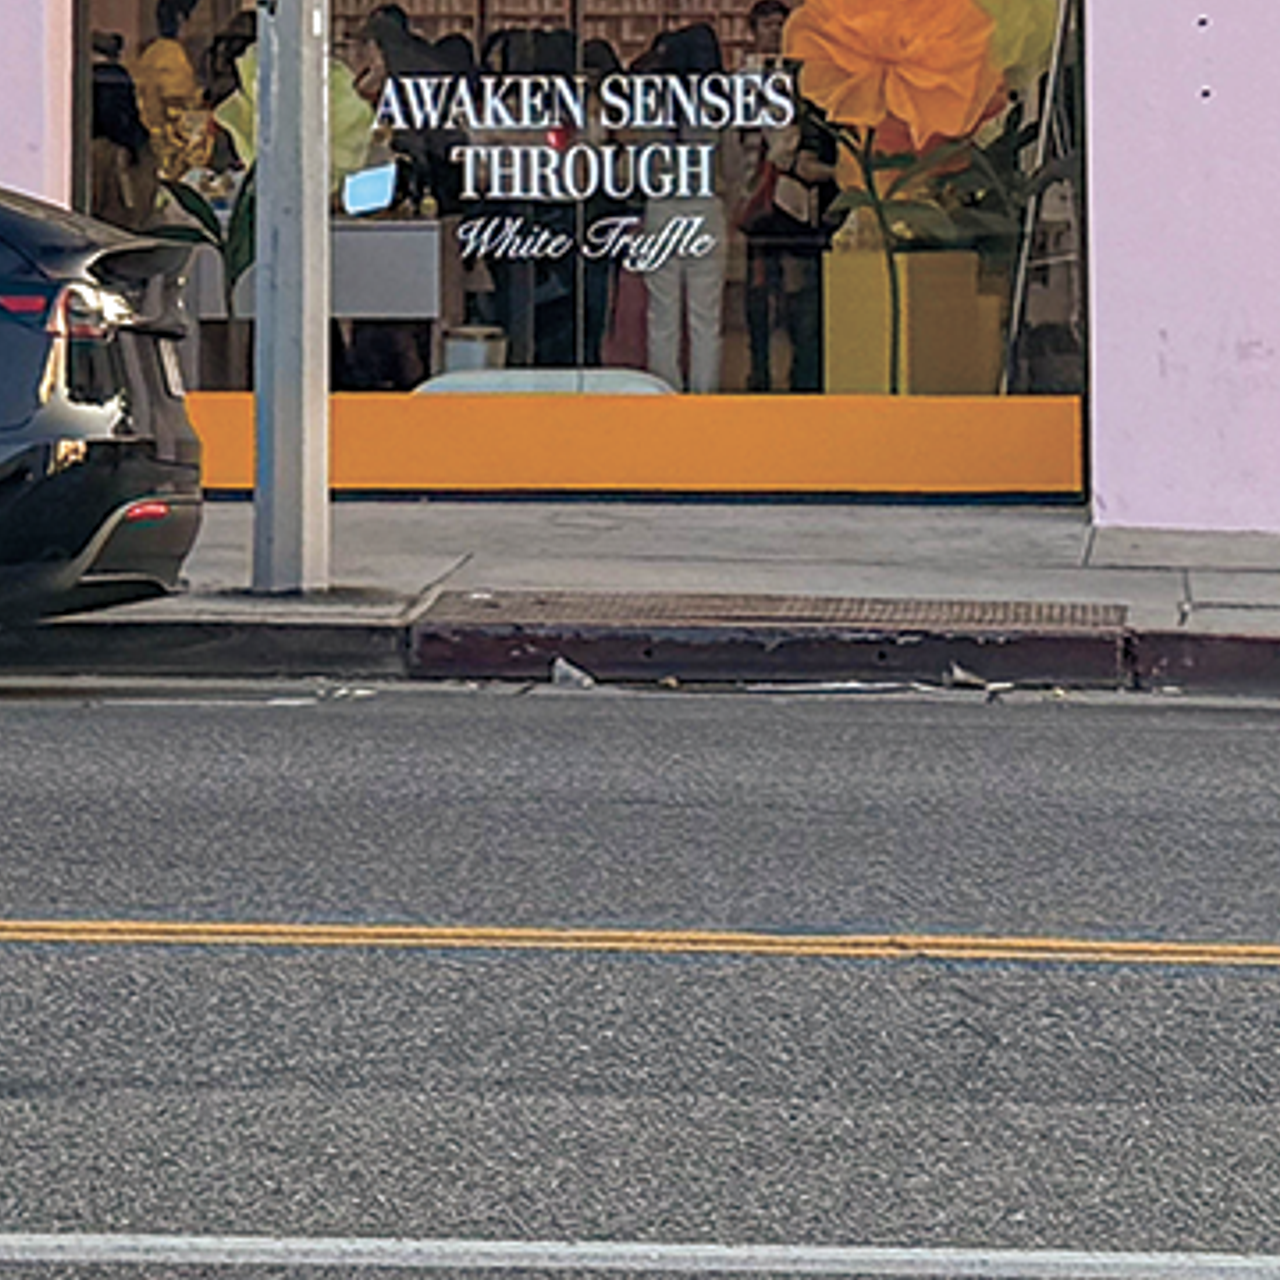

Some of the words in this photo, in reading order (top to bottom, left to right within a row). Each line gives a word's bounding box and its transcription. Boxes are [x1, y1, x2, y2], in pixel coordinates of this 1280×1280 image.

[371, 73, 588, 131] AWAKEN
[600, 71, 795, 130] SENSES
[450, 143, 713, 200] THROUGH
[456, 215, 573, 260] White
[580, 214, 718, 272] Truffle
